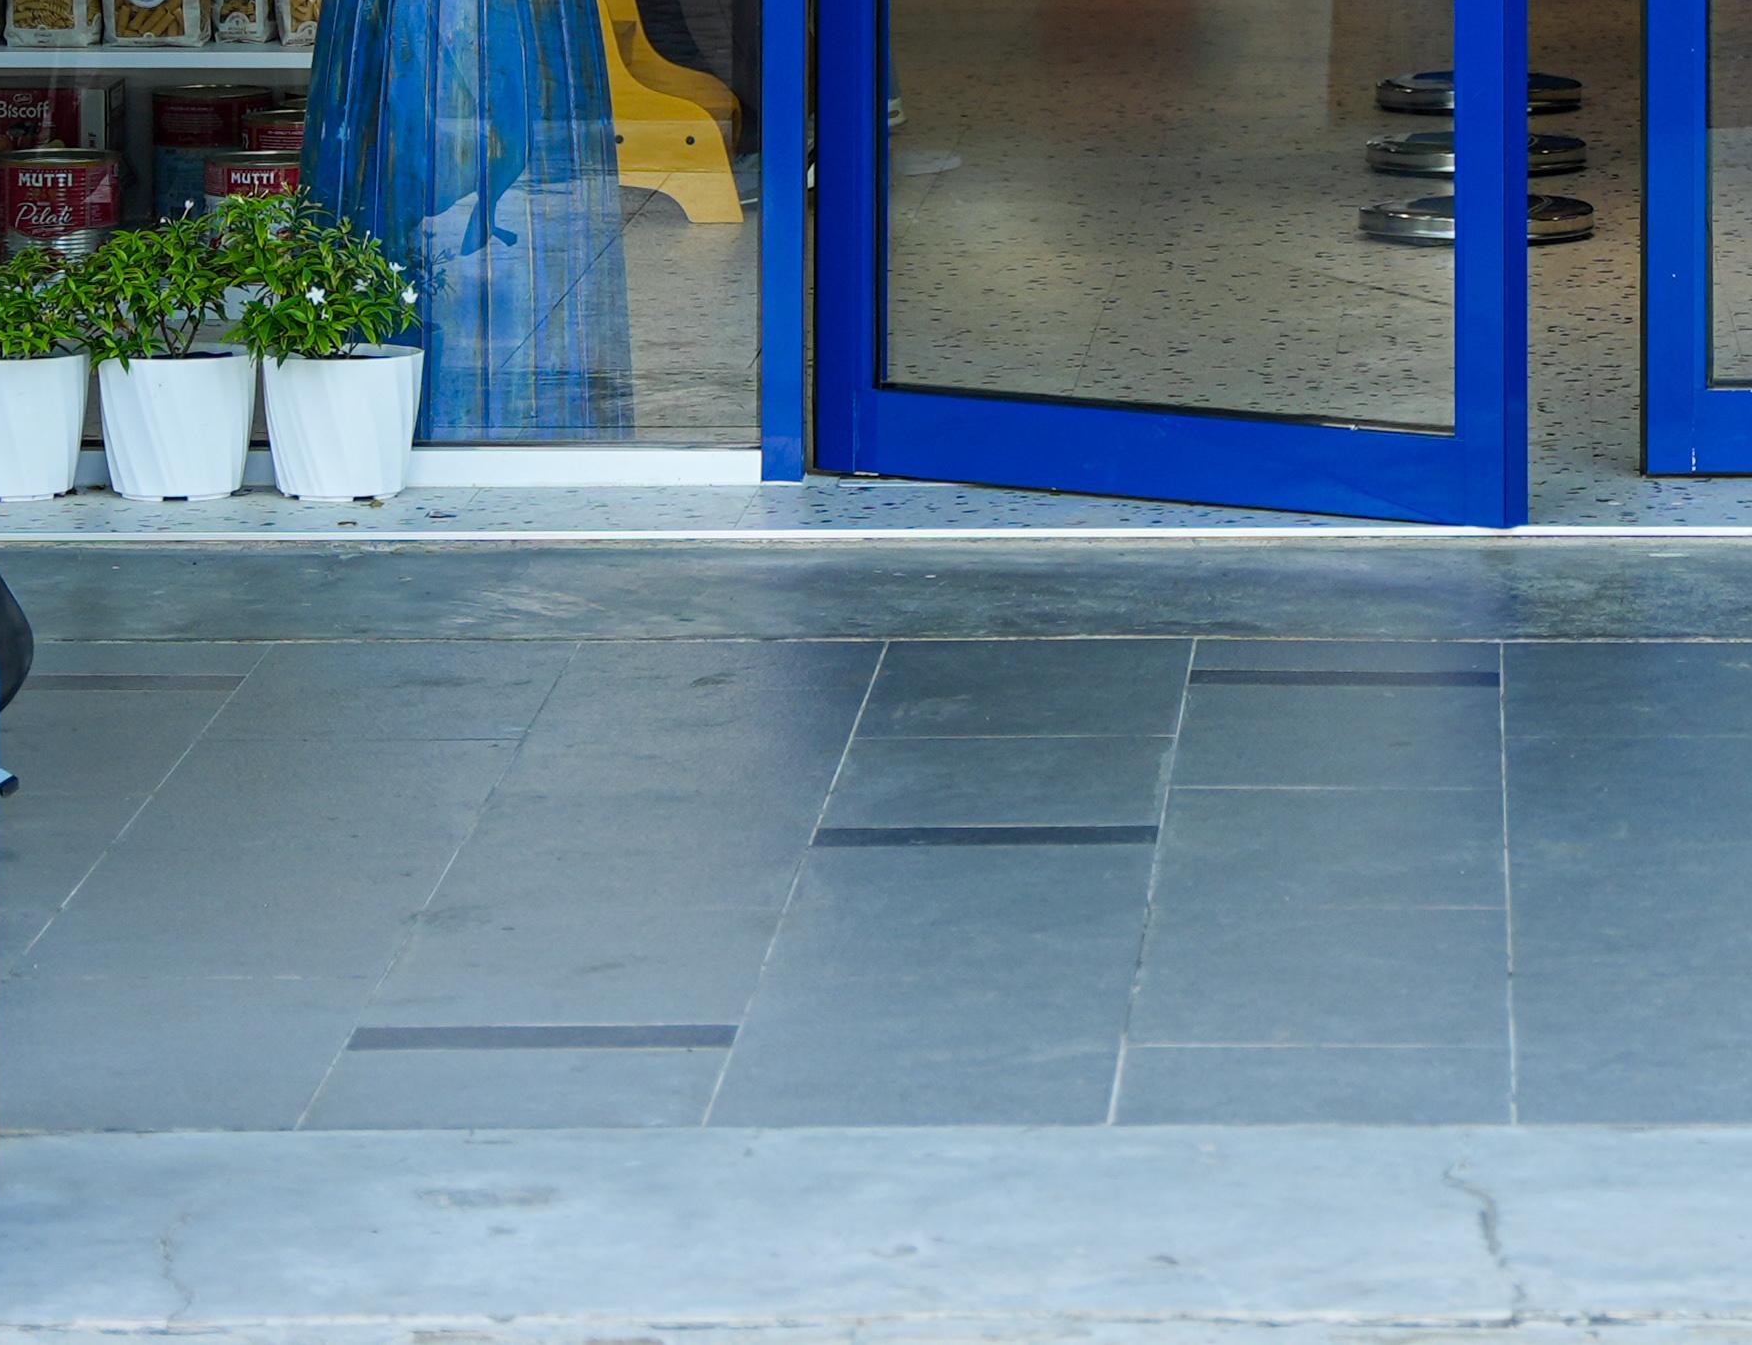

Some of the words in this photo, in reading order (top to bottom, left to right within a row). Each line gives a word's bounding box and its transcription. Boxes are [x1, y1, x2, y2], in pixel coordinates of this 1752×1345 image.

[17, 173, 73, 188] MUTTI
[230, 172, 275, 185] MUTTI
[14, 202, 74, 229] Pelati
